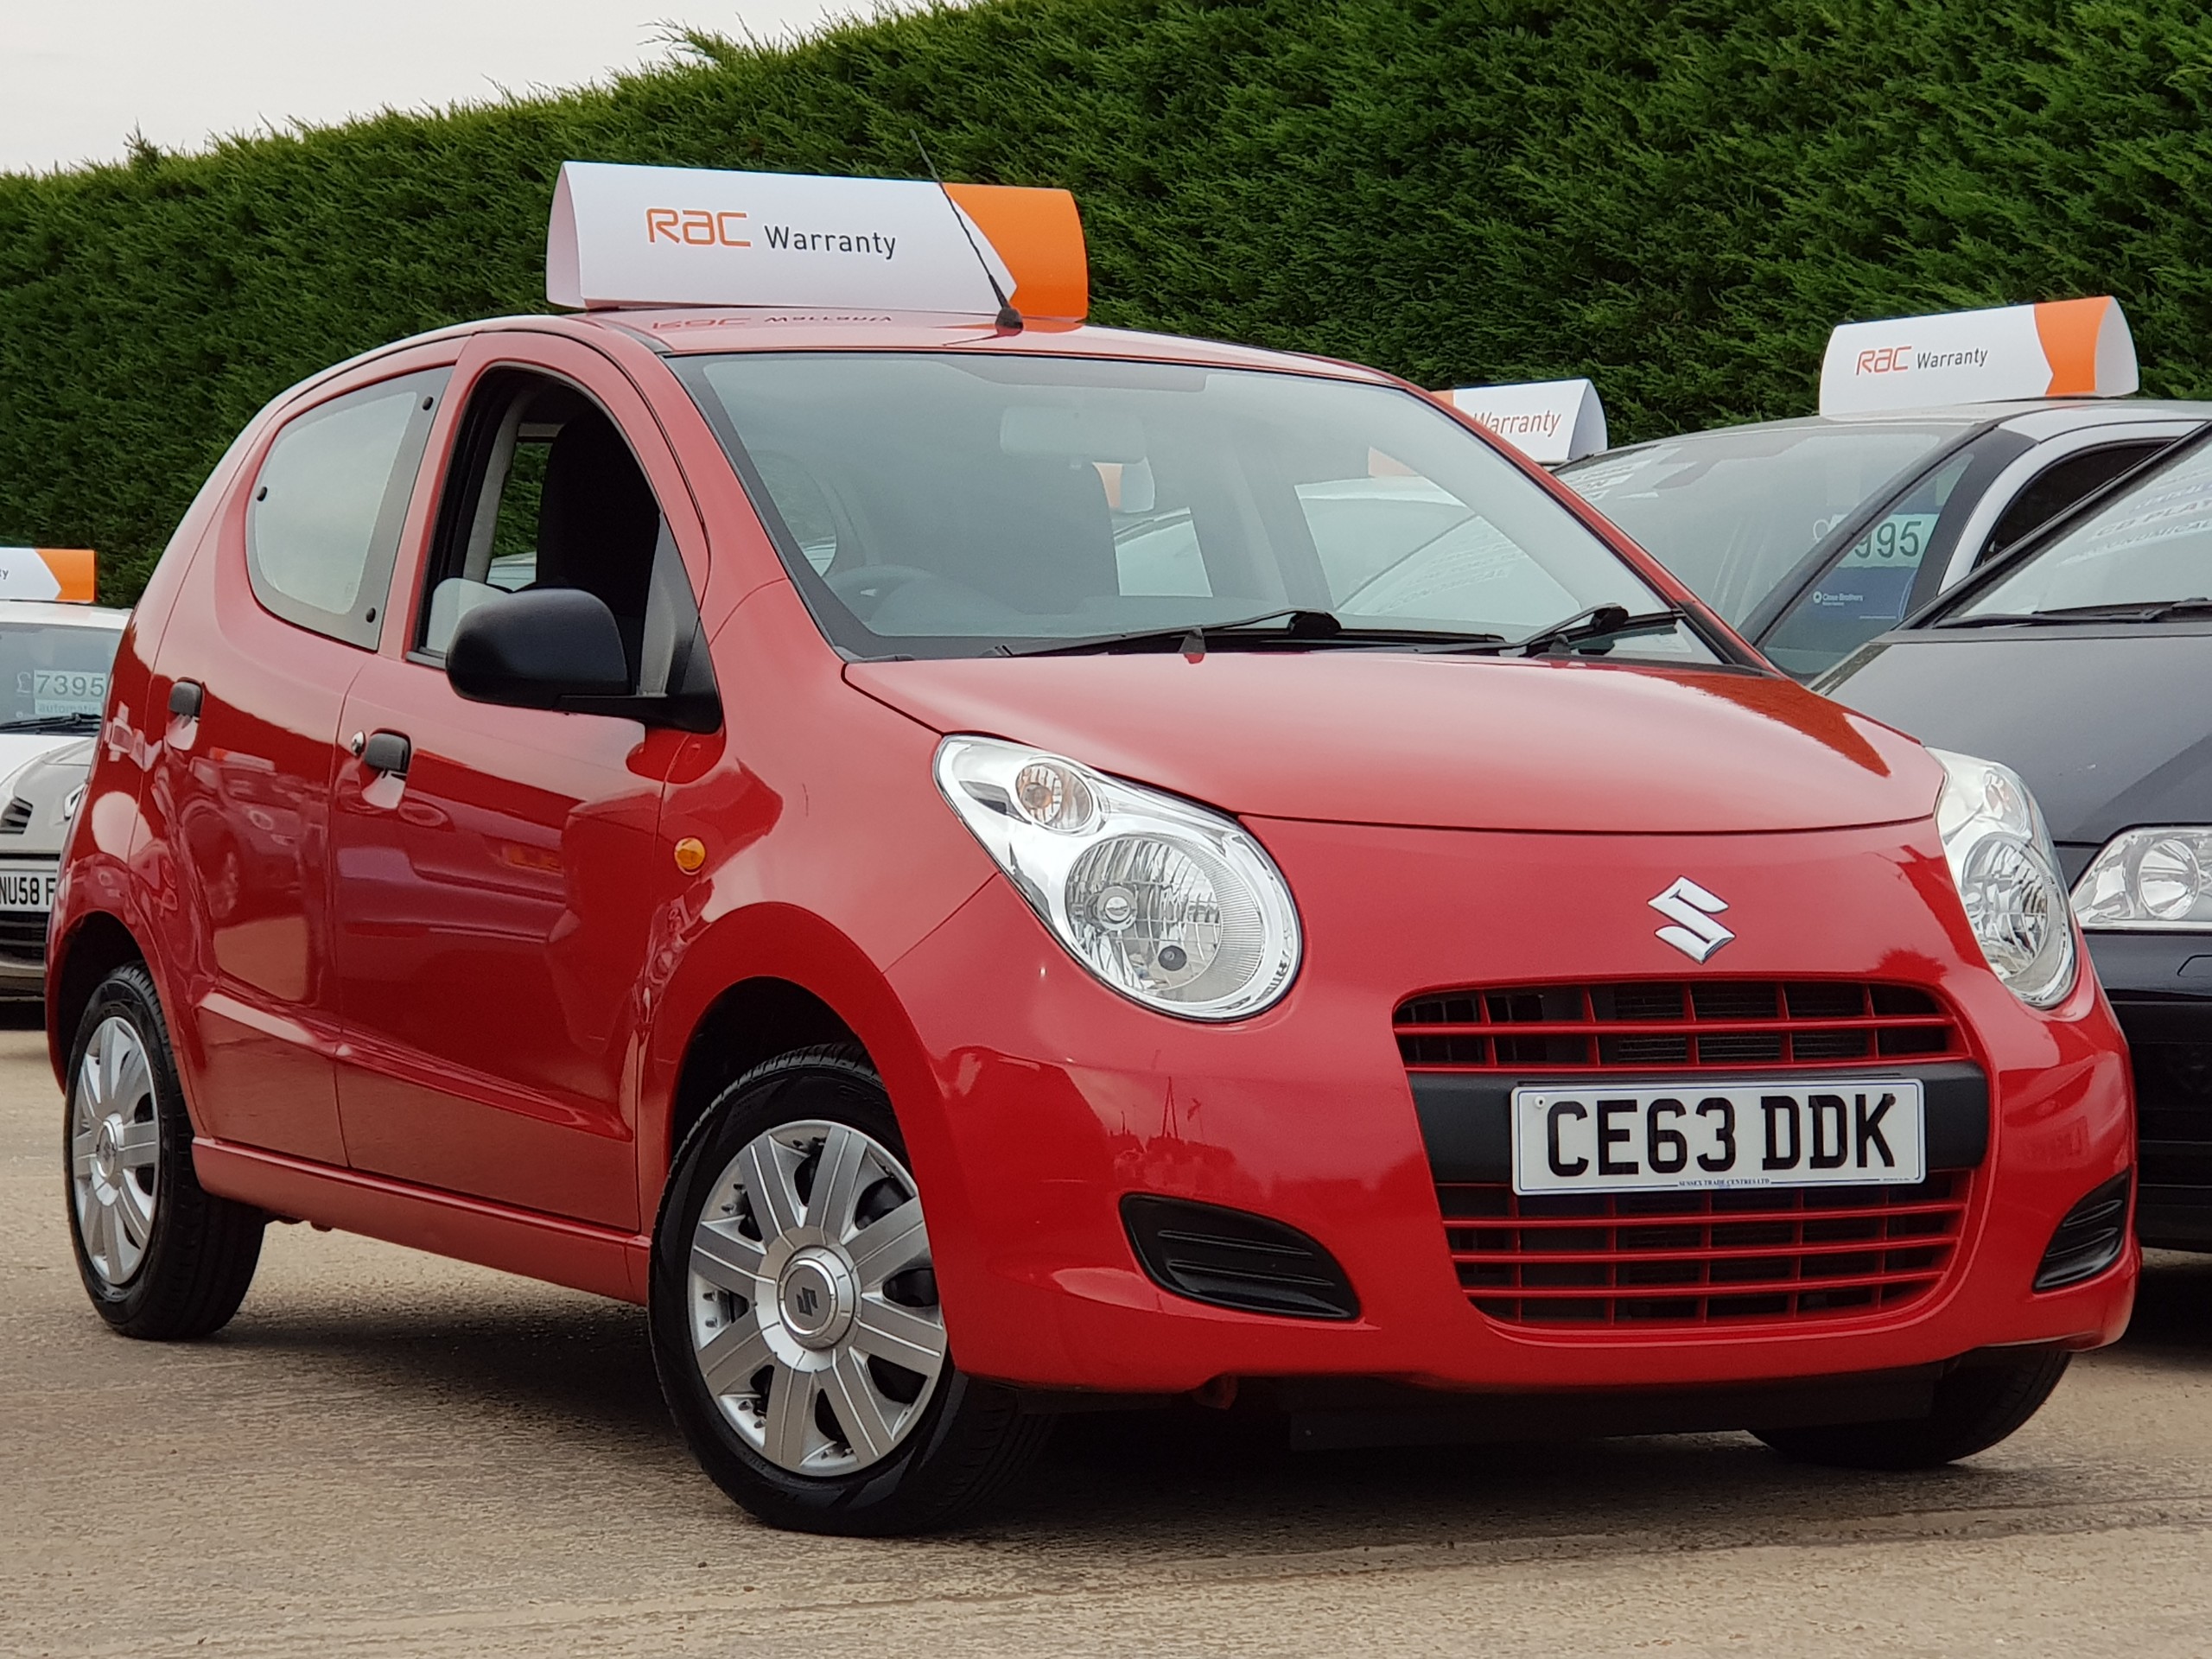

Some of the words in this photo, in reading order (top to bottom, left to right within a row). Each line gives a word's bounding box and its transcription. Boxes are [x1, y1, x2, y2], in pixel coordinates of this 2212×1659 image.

[764, 224, 896, 260] Warranty
[1916, 347, 1988, 370] Warranty
[0, 876, 40, 906] NU58
[1546, 1096, 1737, 1177] CE63
[1761, 1092, 1897, 1171] DDK
